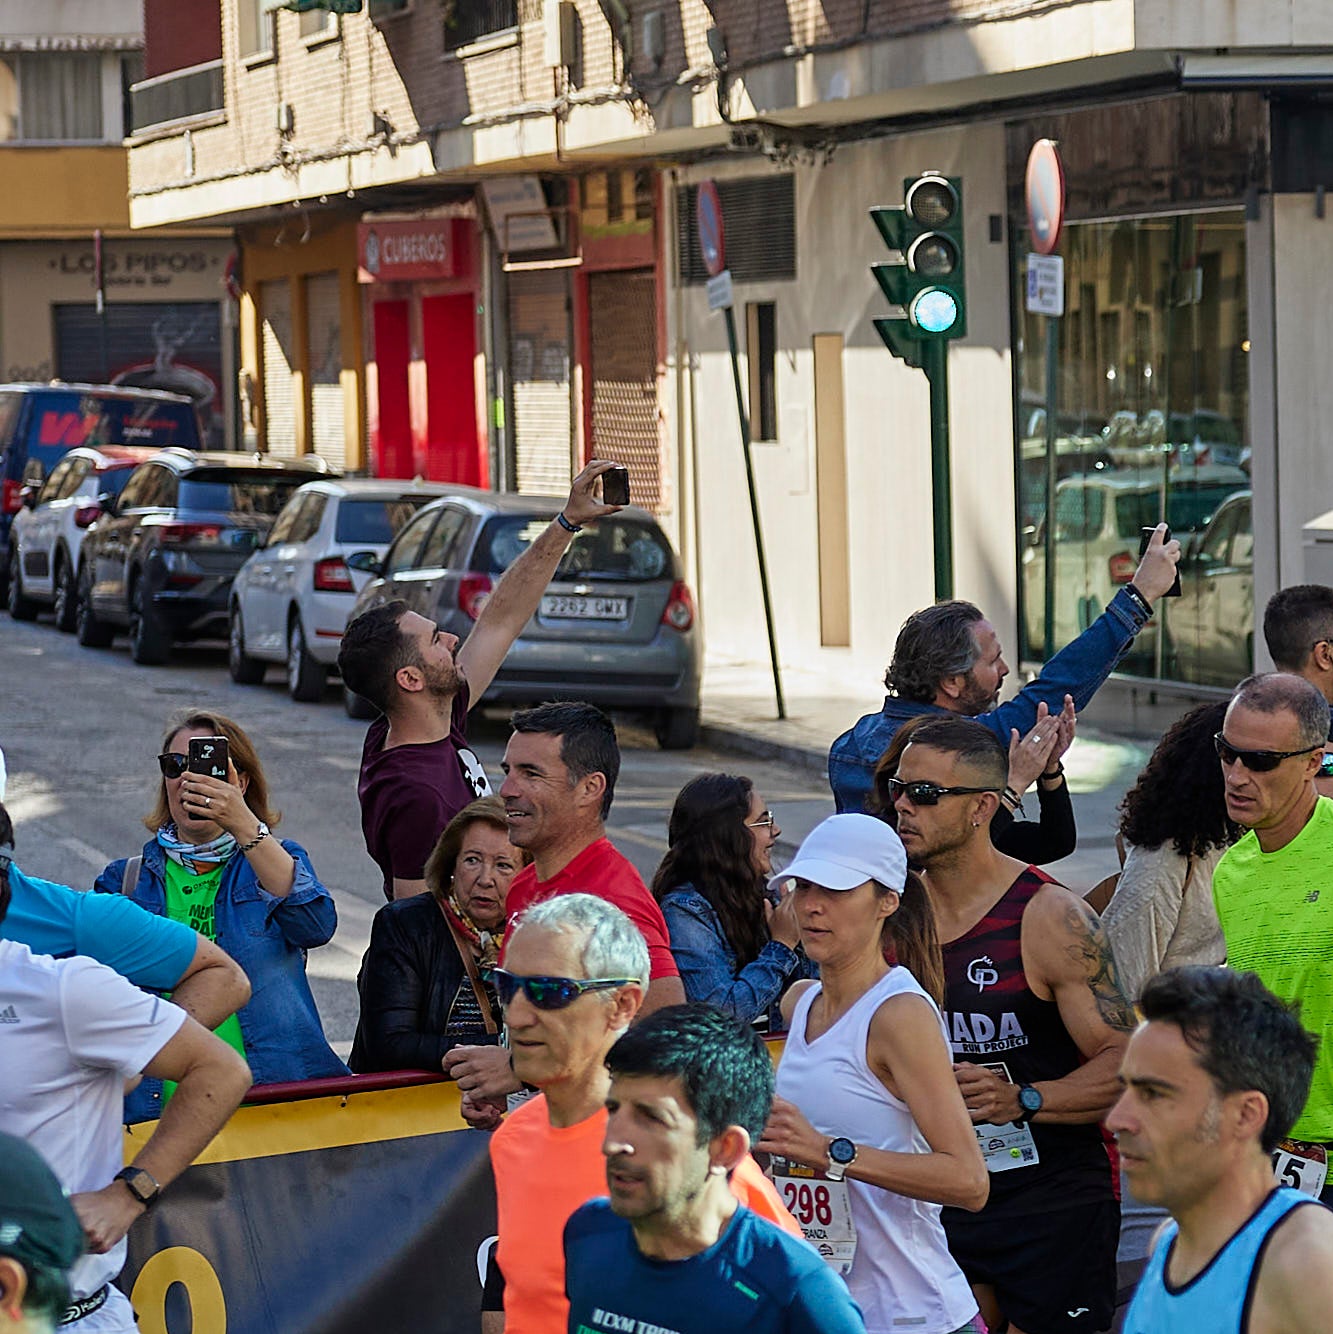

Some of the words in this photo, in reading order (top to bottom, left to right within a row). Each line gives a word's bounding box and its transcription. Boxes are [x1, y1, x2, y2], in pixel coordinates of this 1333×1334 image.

[383, 233, 446, 264] CUBEROS
[126, 252, 207, 273] PIPOS
[962, 1042, 982, 1053] RUN
[983, 1036, 1028, 1053] PROJECT
[783, 1181, 832, 1226] 298
